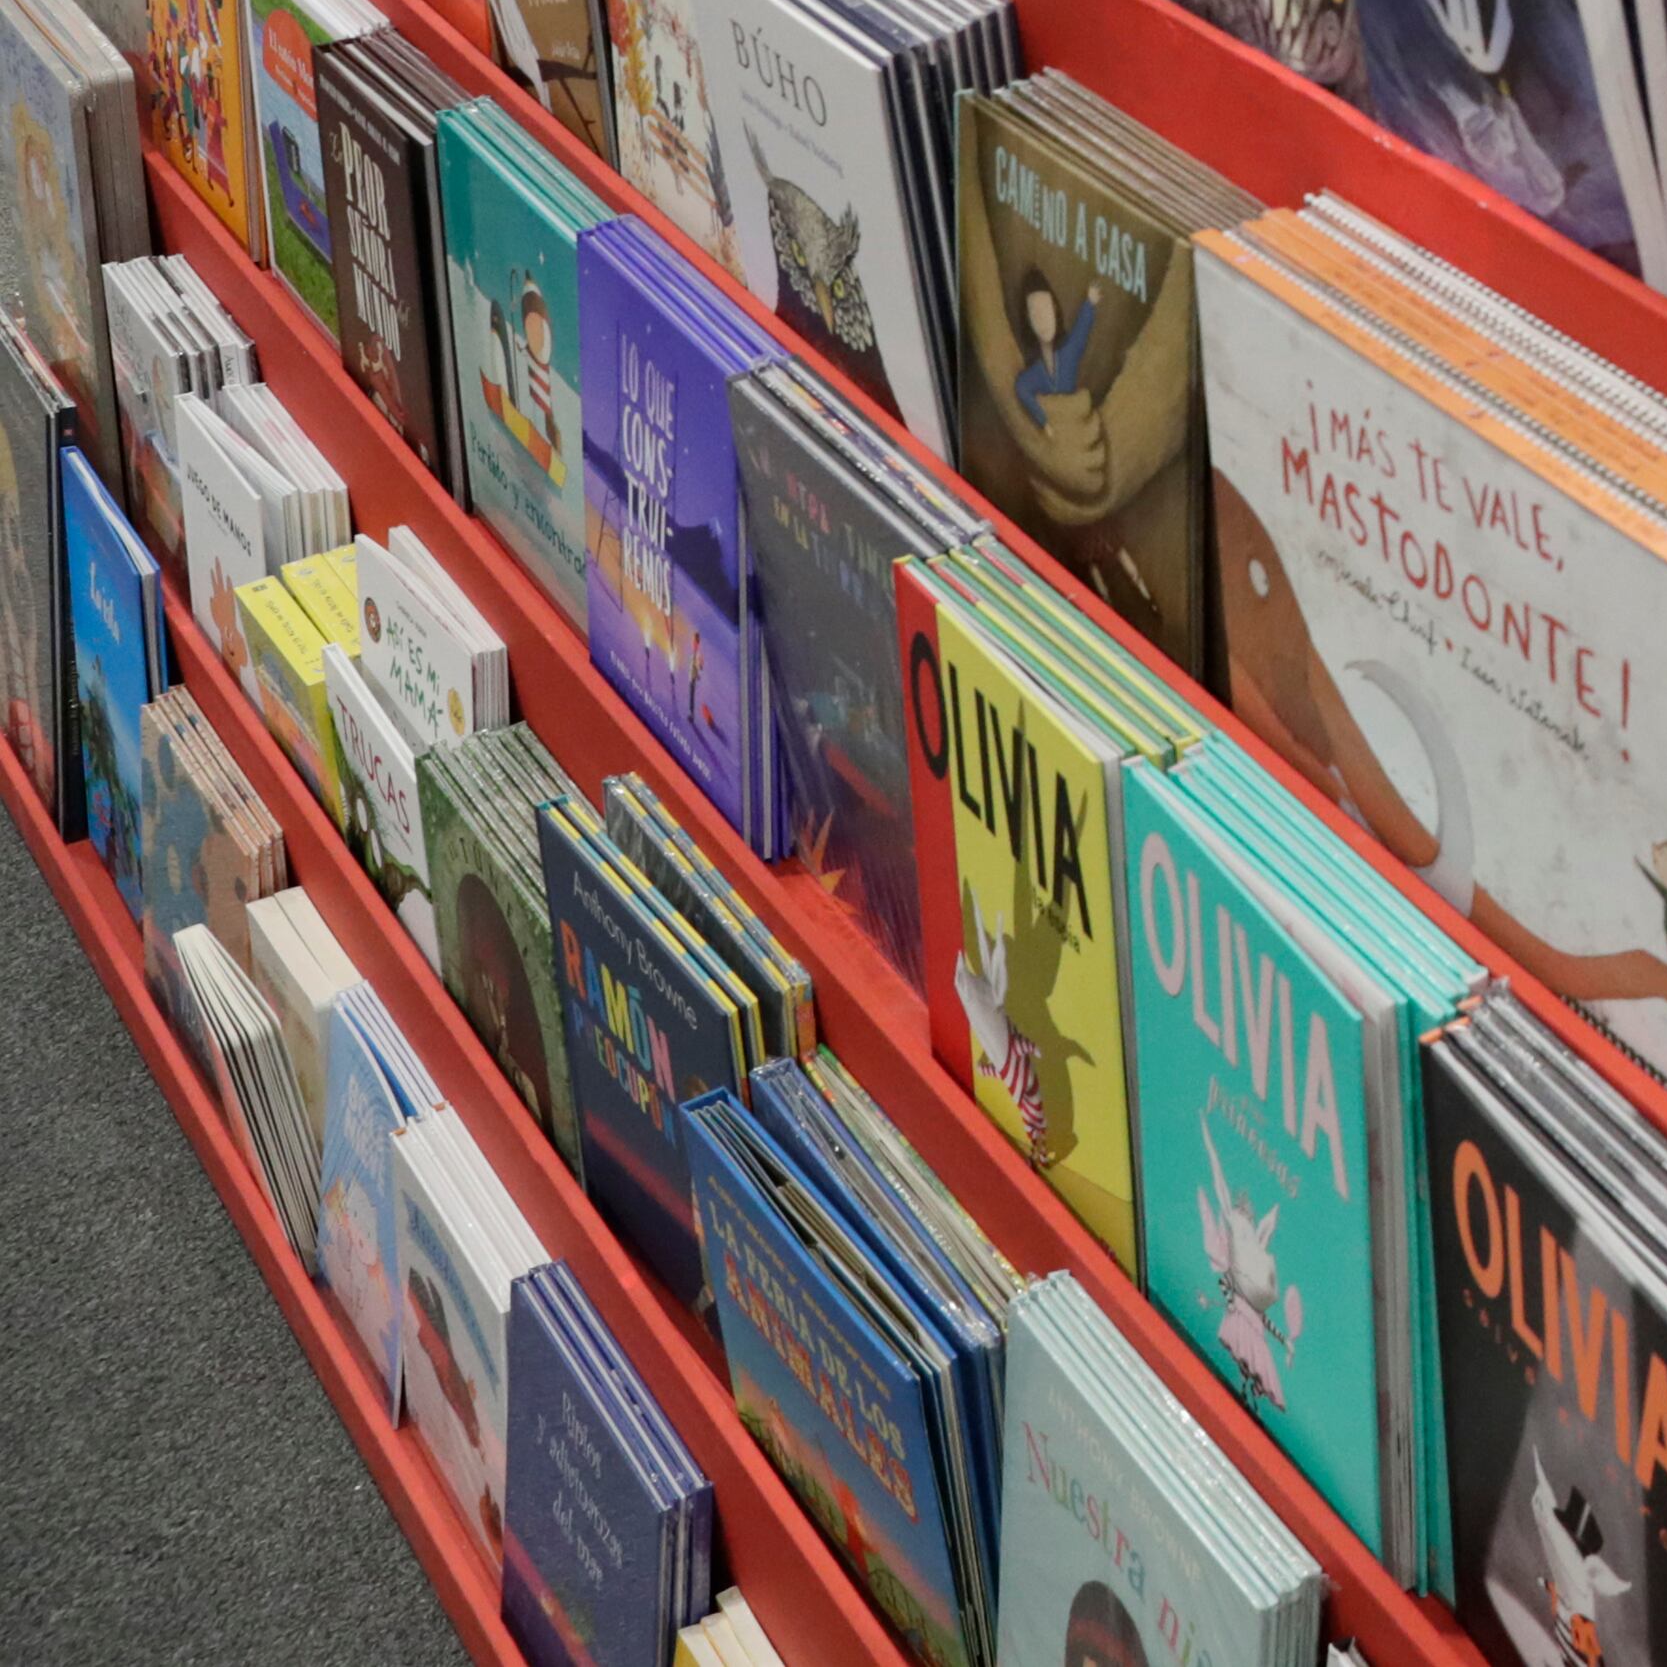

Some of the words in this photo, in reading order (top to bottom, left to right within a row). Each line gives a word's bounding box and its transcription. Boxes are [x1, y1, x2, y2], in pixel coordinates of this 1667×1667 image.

[729, 18, 829, 130] BÚHO
[339, 120, 391, 243] PEOR
[1073, 219, 1089, 261] A
[1093, 233, 1149, 304] CASA
[620, 332, 640, 398] LO
[642, 349, 677, 426] QUE
[210, 497, 222, 522] DE
[620, 408, 674, 498] CONS-
[625, 472, 676, 551] TRUI-
[1408, 439, 1456, 512] TE
[1461, 474, 1566, 575] VALE,
[619, 540, 674, 620] REMOS
[1280, 434, 1634, 764] MASTODONTE!
[408, 642, 424, 670] ES
[335, 694, 412, 835] TRUCAS
[908, 629, 1094, 941] OLIVIA
[559, 917, 676, 1106] RAMÓN
[573, 870, 634, 966] Anthony
[635, 937, 700, 1032] Browne
[1138, 831, 1351, 1205] OLIVIA
[724, 1251, 921, 1526] ANIMALES
[744, 1242, 816, 1355] FERIA
[854, 1379, 907, 1461] LOS
[1021, 1419, 1147, 1605] Nuestra
